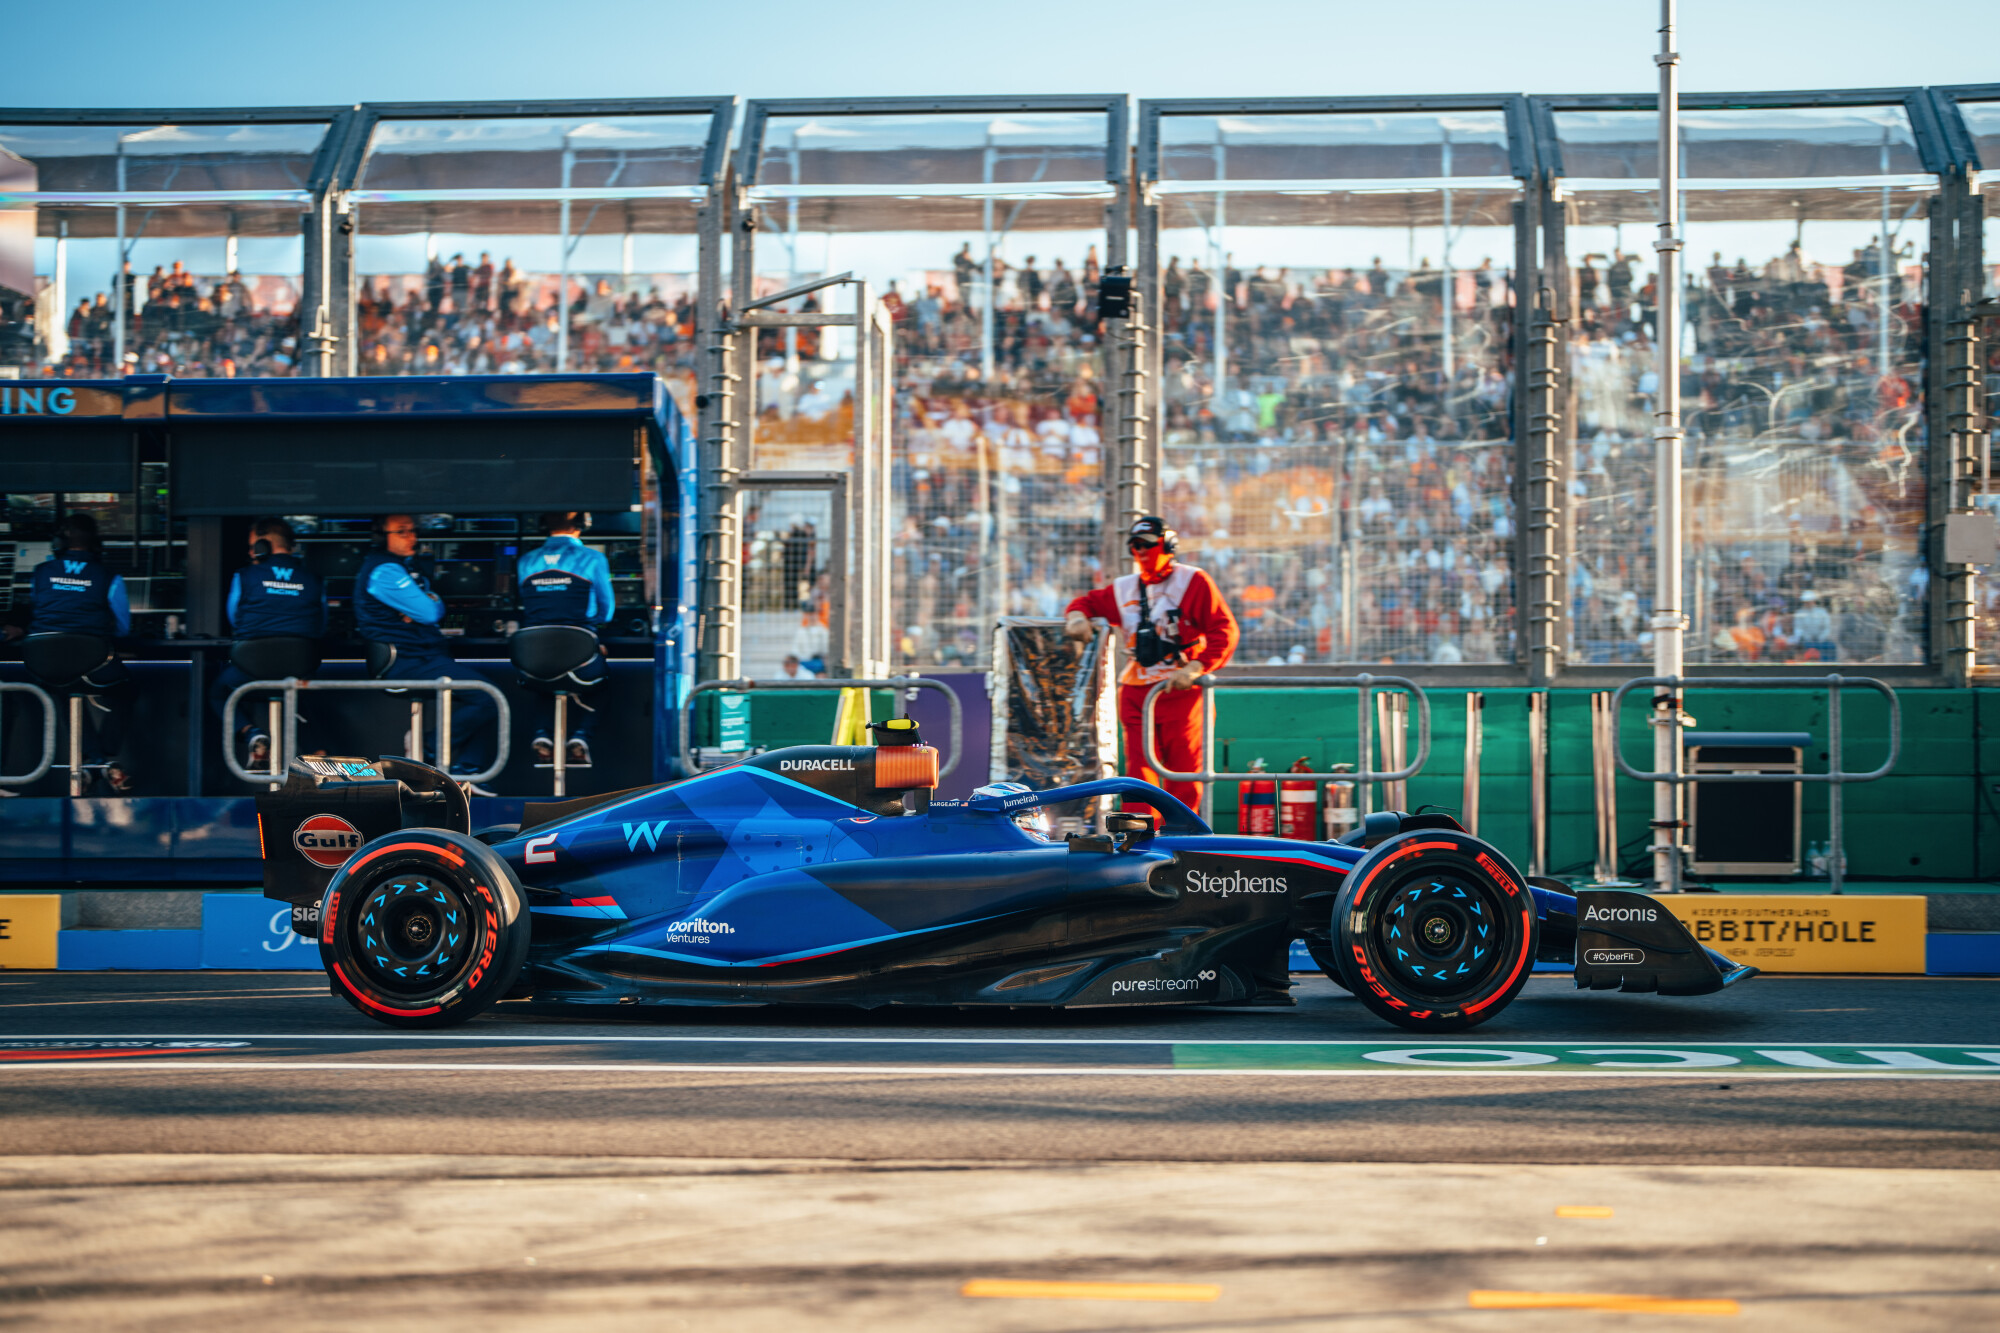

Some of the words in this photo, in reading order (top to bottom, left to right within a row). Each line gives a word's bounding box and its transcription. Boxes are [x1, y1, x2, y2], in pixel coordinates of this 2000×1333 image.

[0, 386, 77, 415] ING
[780, 758, 856, 771] DURACELL
[1003, 793, 1039, 809] Jumeirah
[297, 832, 359, 848] Gulf
[1185, 869, 1288, 898] Stephens
[1475, 851, 1520, 898] PIRELLI
[1584, 904, 1658, 922] Acronis
[666, 932, 711, 944] Ventures
[467, 908, 499, 990] ZERO
[1593, 952, 1635, 962] #CyberFit
[1111, 976, 1199, 996] purestream
[1352, 944, 1409, 1011] ZERO
